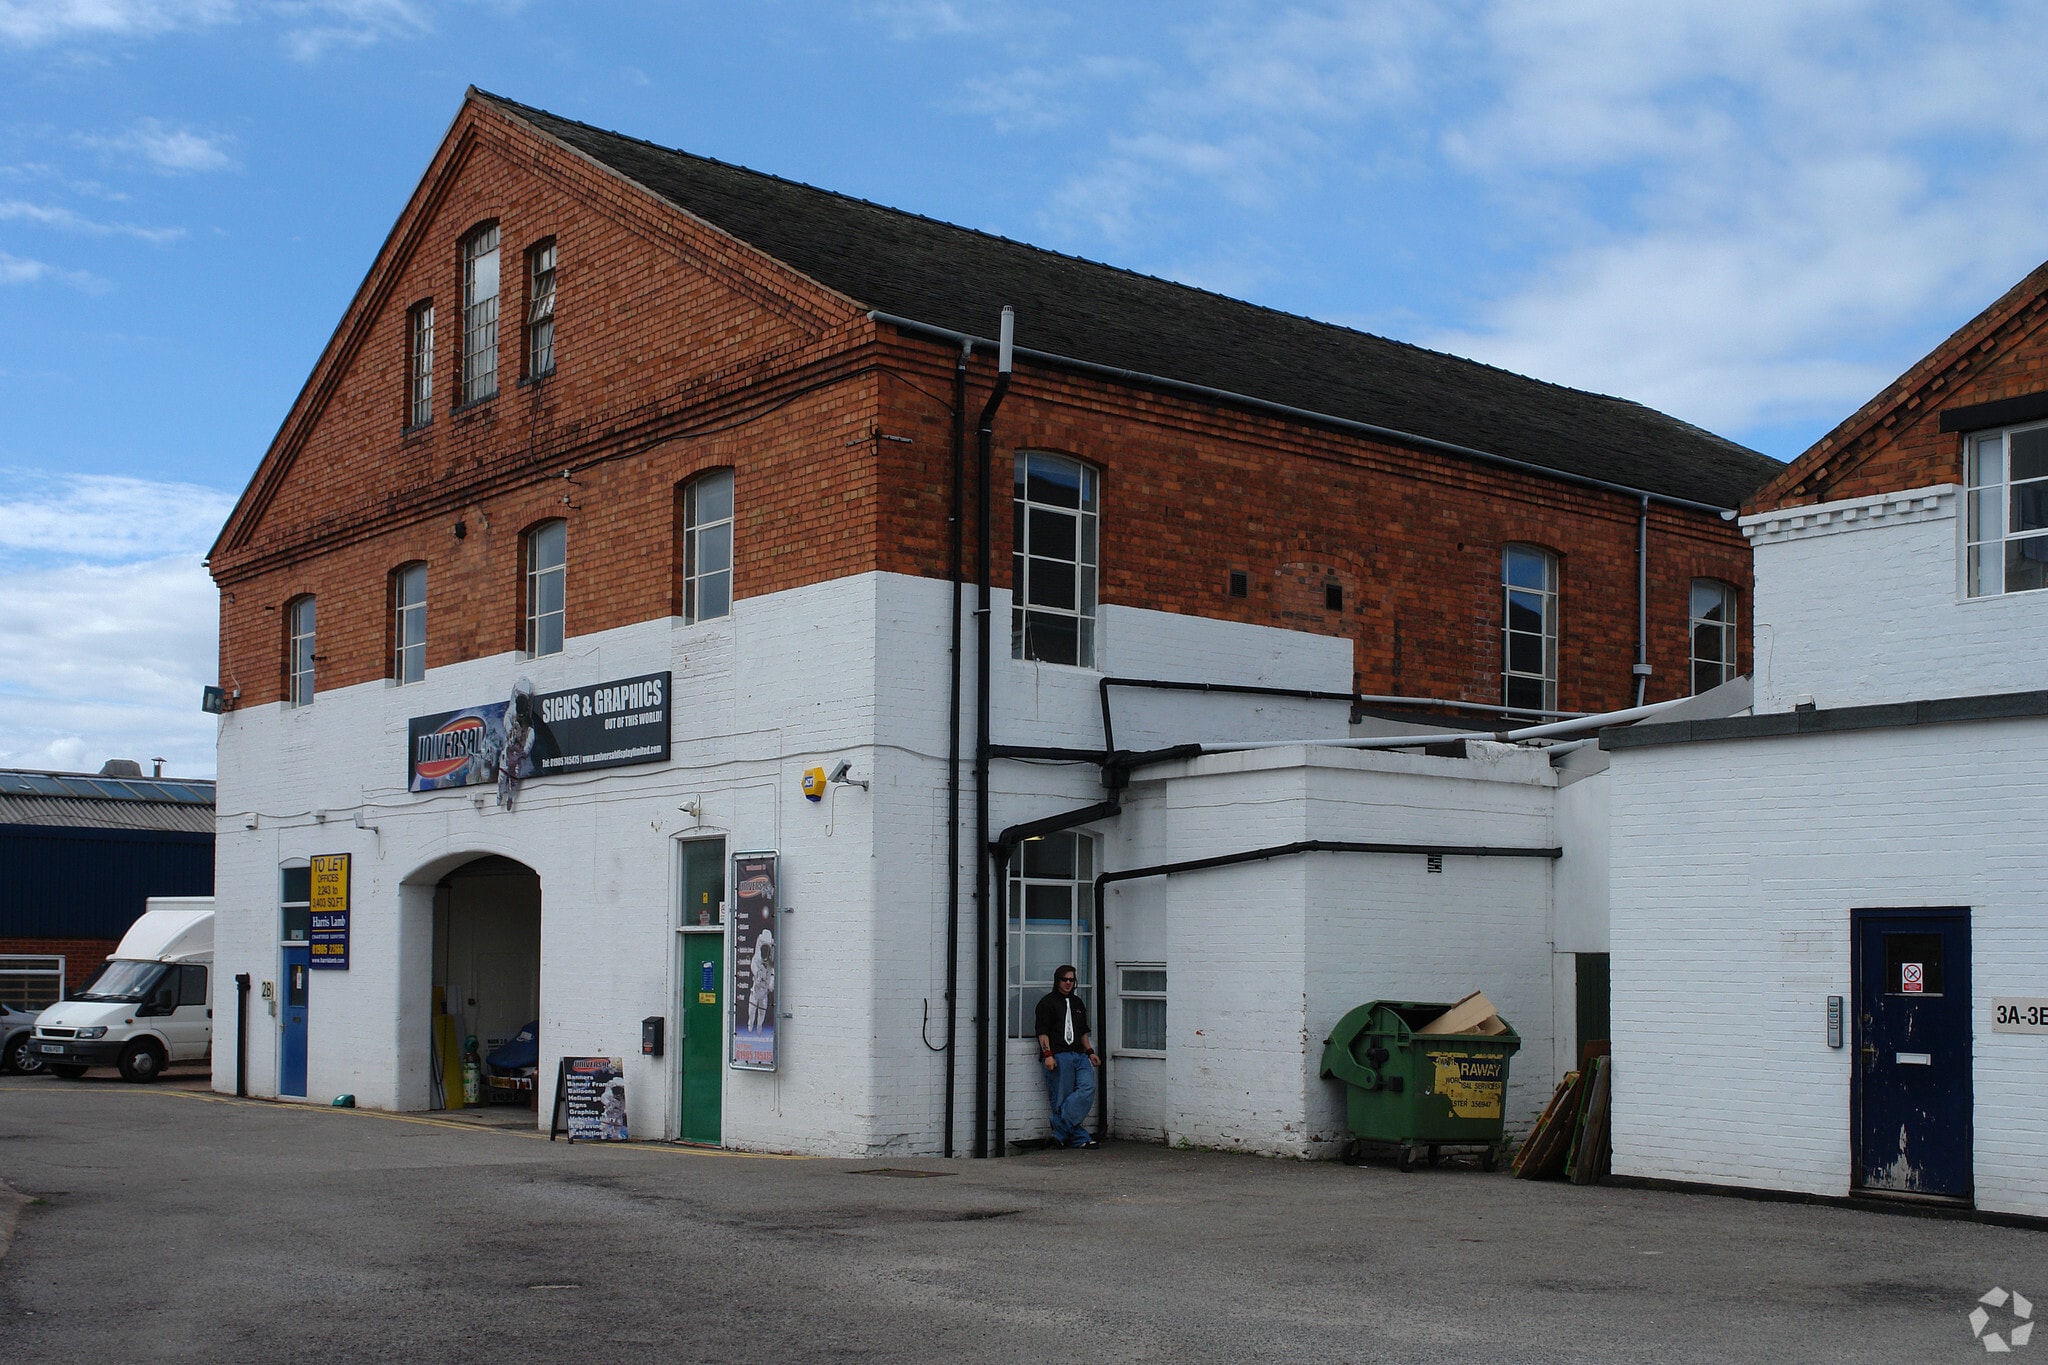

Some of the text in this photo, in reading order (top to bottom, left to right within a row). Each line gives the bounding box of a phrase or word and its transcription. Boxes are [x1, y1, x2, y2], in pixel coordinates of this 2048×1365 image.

[542, 679, 662, 724] SIGNS & GRAPHICS
[604, 710, 662, 730] OUT OF THIS WORLD!
[417, 726, 484, 765] UNIVERSAL
[313, 857, 345, 873] TO LET
[317, 873, 339, 883] OFFICES
[332, 885, 339, 895] to
[312, 914, 346, 928] Harris Lamb
[261, 981, 272, 998] 2B
